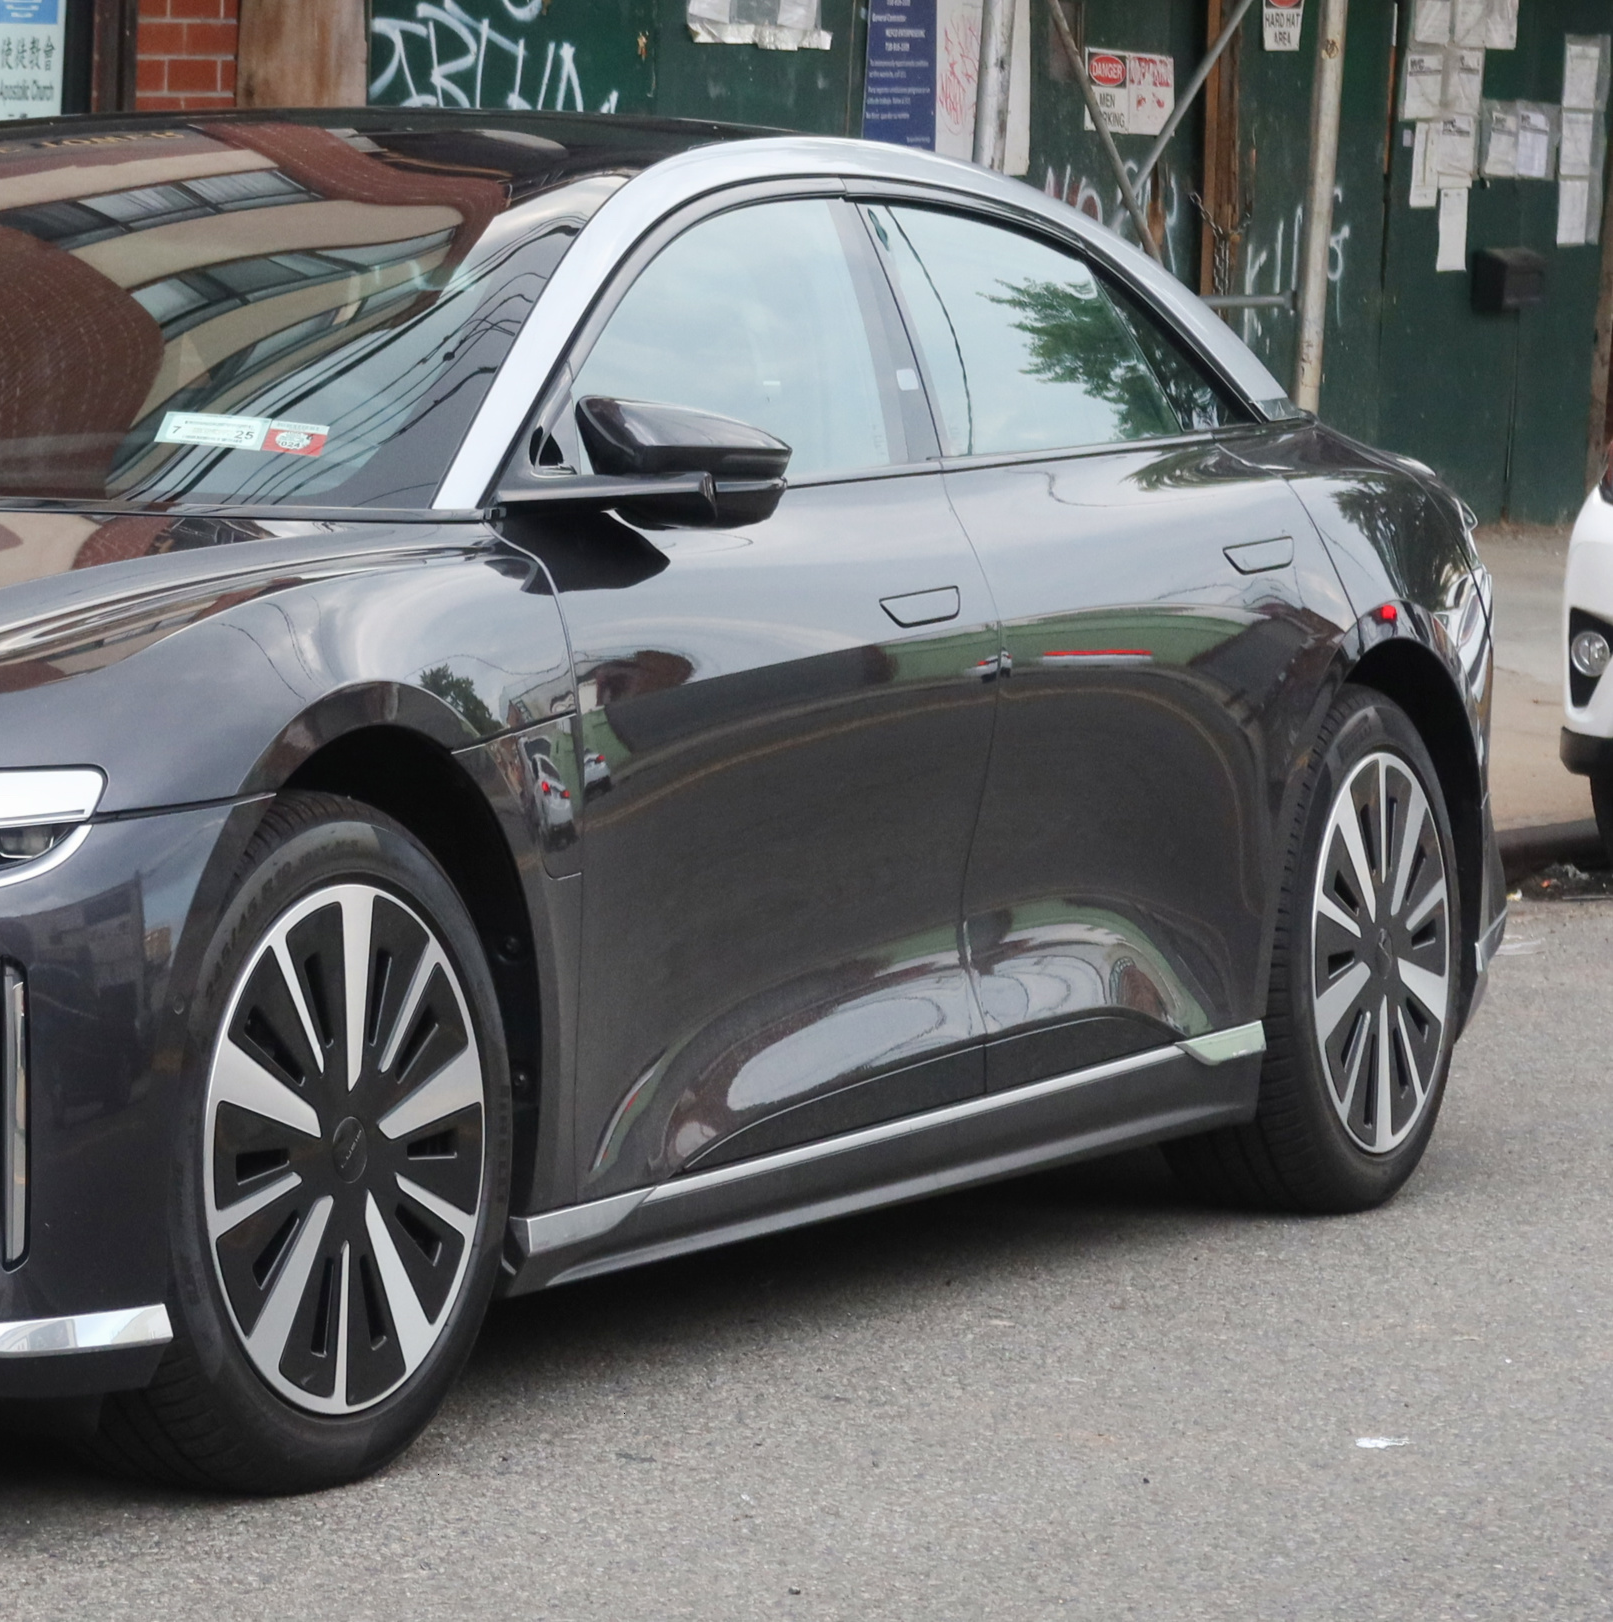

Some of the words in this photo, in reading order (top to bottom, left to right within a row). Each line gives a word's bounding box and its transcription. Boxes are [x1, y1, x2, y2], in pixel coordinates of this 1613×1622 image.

[1265, 12, 1285, 28] HARD
[1287, 13, 1301, 29] HAT
[1274, 31, 1292, 46] AREA
[1091, 61, 1124, 80] DANGER
[0, 79, 29, 106] Apostolic
[31, 80, 54, 101] Church
[1099, 93, 1116, 108] MEN
[234, 431, 255, 440] 25
